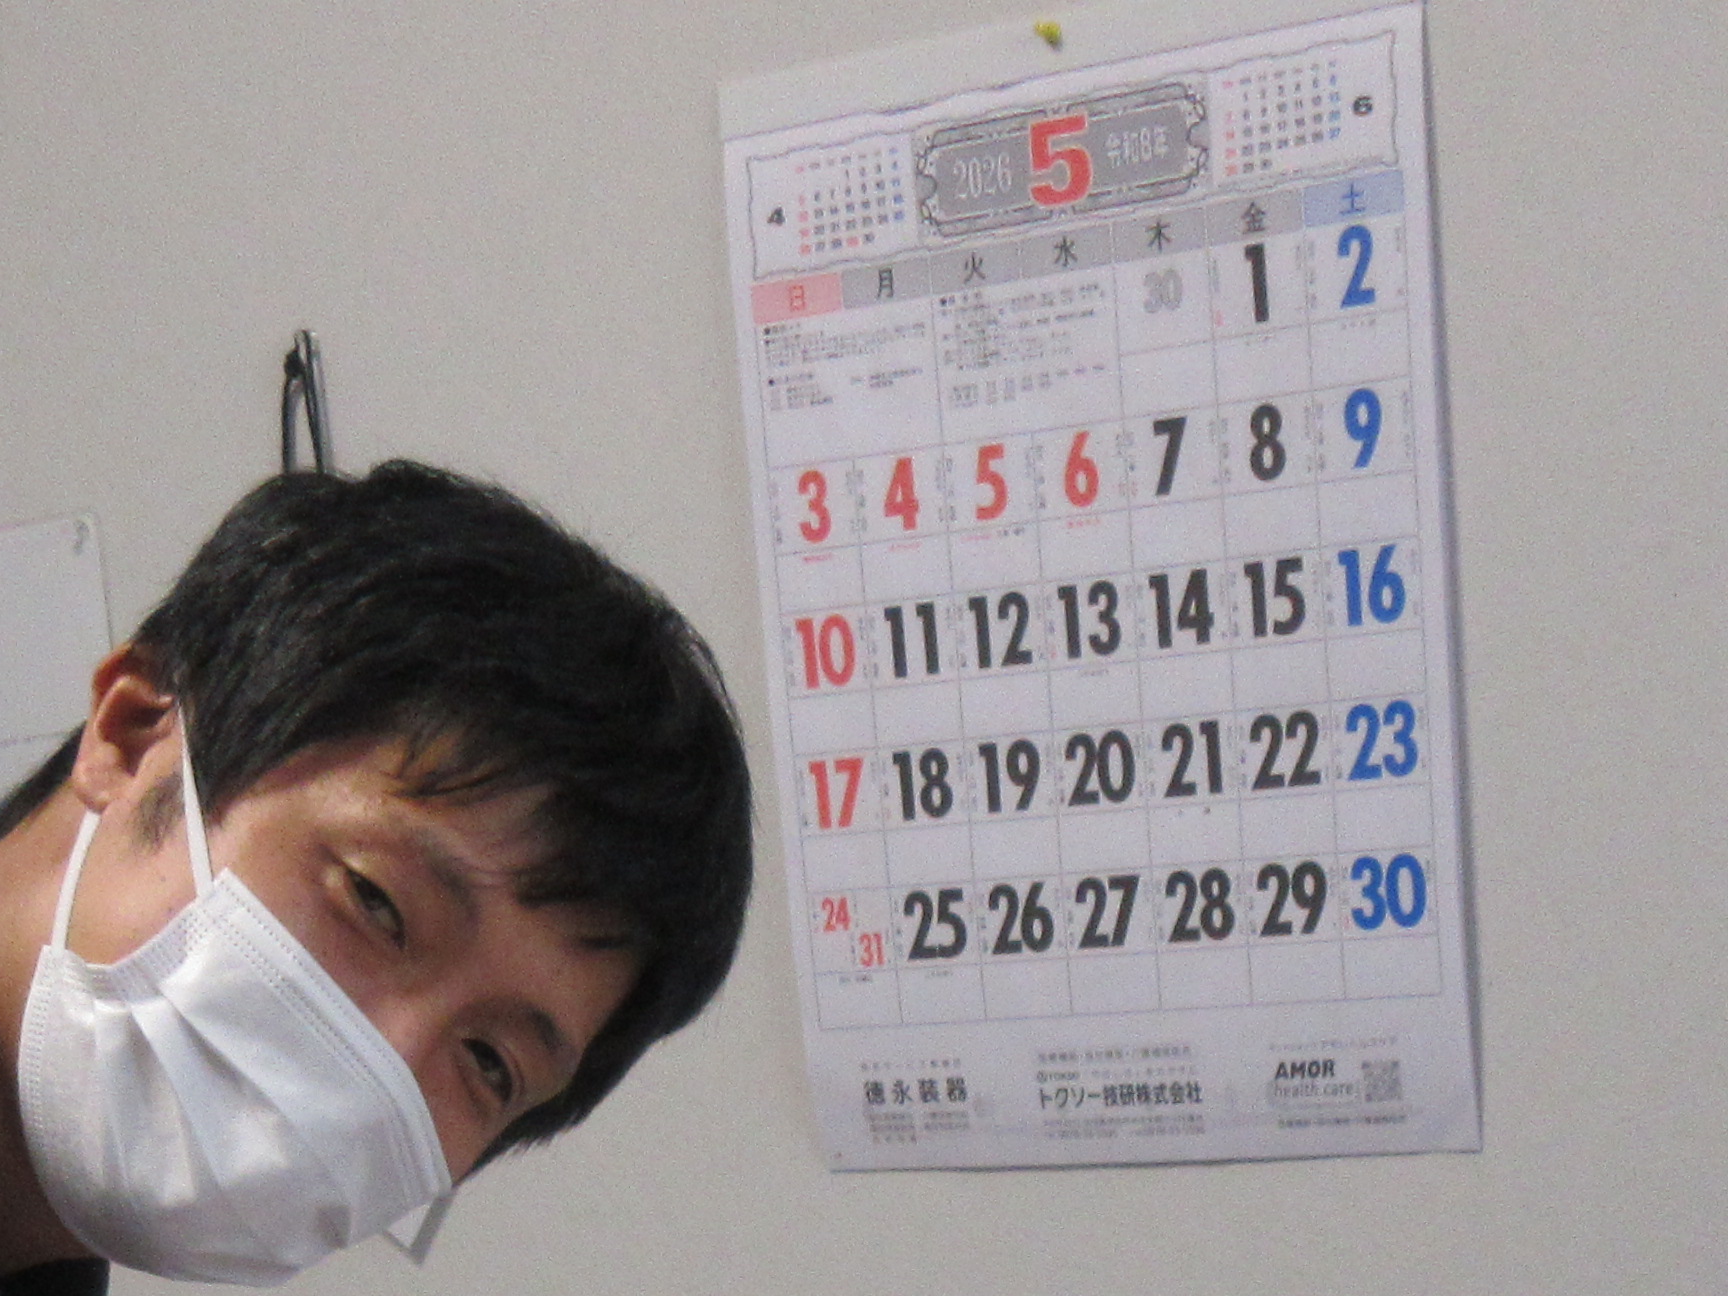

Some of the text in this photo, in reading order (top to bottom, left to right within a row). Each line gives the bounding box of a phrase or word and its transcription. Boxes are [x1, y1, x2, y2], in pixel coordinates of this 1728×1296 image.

[953, 152, 1012, 199] 2026
[1029, 113, 1093, 207] 5
[767, 208, 785, 226] 4
[787, 184, 1365, 311] 日 月 火 水 木 金 土
[1143, 225, 1375, 323] 30 1 2
[799, 389, 1381, 543] 3 4 5 6 7 8 9
[796, 545, 1405, 688] 10 11 12 13 14 15 16
[809, 701, 1417, 828] 17 18 19 20 21 22 23
[822, 854, 1426, 960] 24 25 26 27 28 29 30
[860, 933, 883, 967] 31
[1275, 1059, 1335, 1080] AMOR
